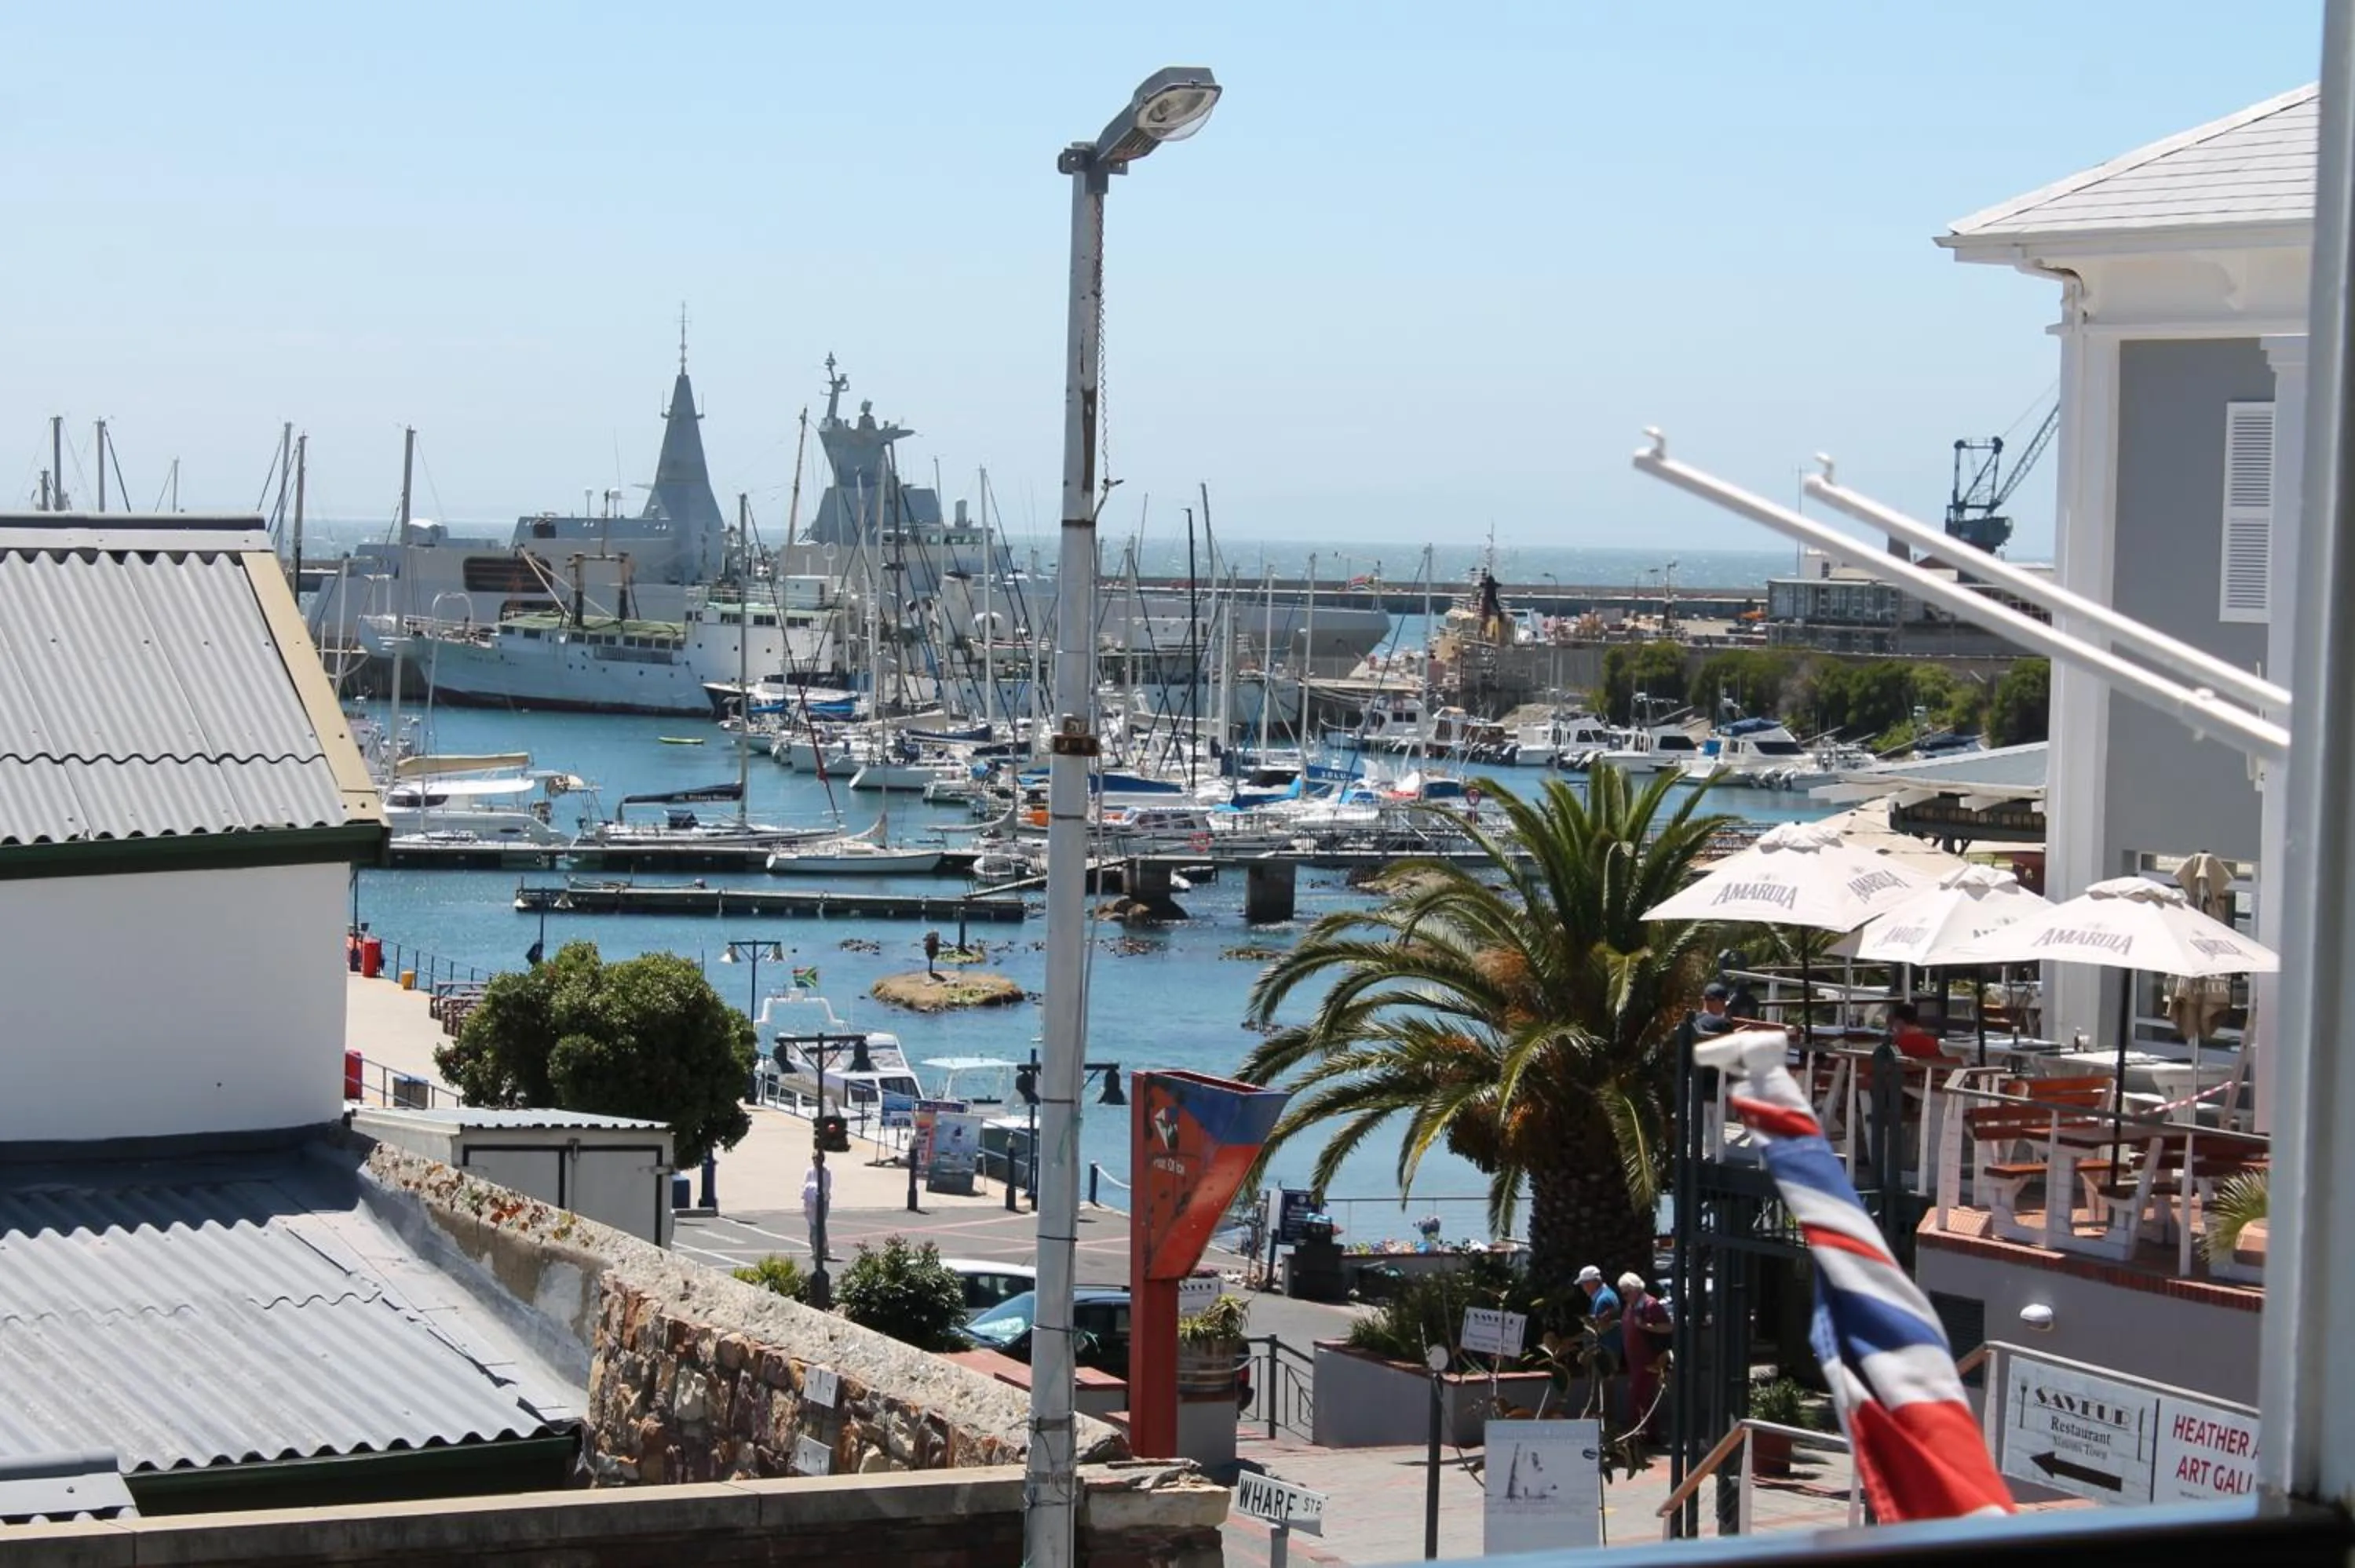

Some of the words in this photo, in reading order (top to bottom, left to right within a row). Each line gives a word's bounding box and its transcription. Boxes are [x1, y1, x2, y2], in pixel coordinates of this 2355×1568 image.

[1711, 881, 1798, 910] AMARULA
[2032, 926, 2134, 957] AMARULA
[2050, 1415, 2112, 1446] Restaurant
[2172, 1413, 2250, 1457] HEATHER
[2175, 1455, 2211, 1486] ART
[1239, 1477, 1297, 1521] WHARF
